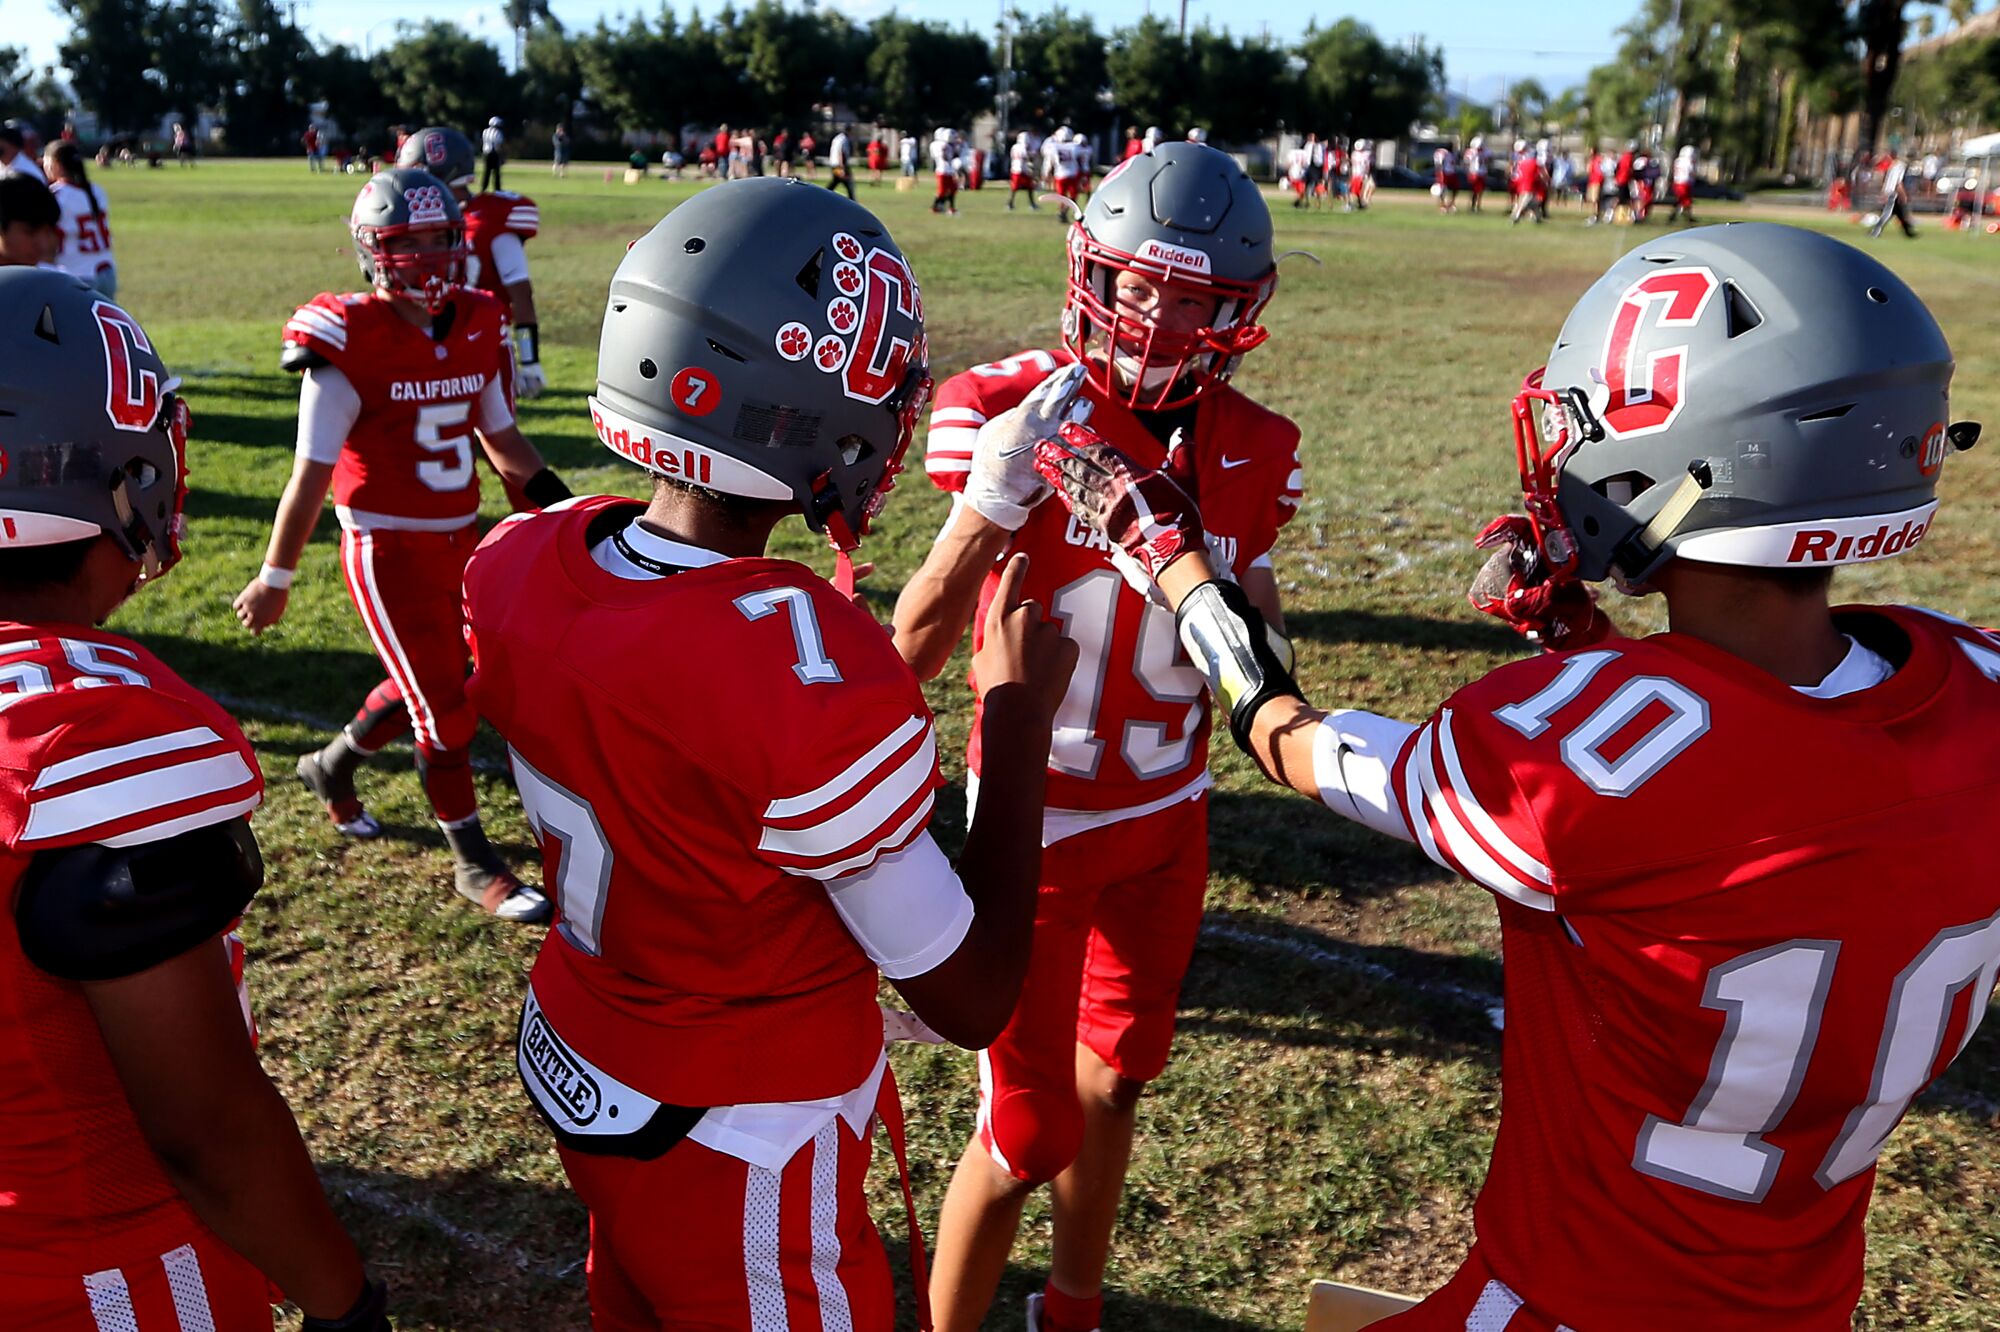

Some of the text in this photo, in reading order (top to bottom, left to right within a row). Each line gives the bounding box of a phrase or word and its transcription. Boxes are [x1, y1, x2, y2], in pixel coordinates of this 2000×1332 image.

[1148, 244, 1205, 267] Riddell
[91, 300, 160, 432] C
[685, 376, 706, 407] 7
[1599, 266, 1719, 440] C
[415, 400, 473, 491] 5
[593, 409, 711, 484] Riddell
[1923, 424, 1946, 467] 10
[1786, 510, 1938, 563] Riddel
[732, 586, 843, 685] 7
[1048, 568, 1204, 781] 15
[1492, 650, 1711, 798] 10
[507, 740, 614, 957] 7
[527, 1021, 592, 1115] BATTLE
[1631, 907, 2000, 1204] 10
